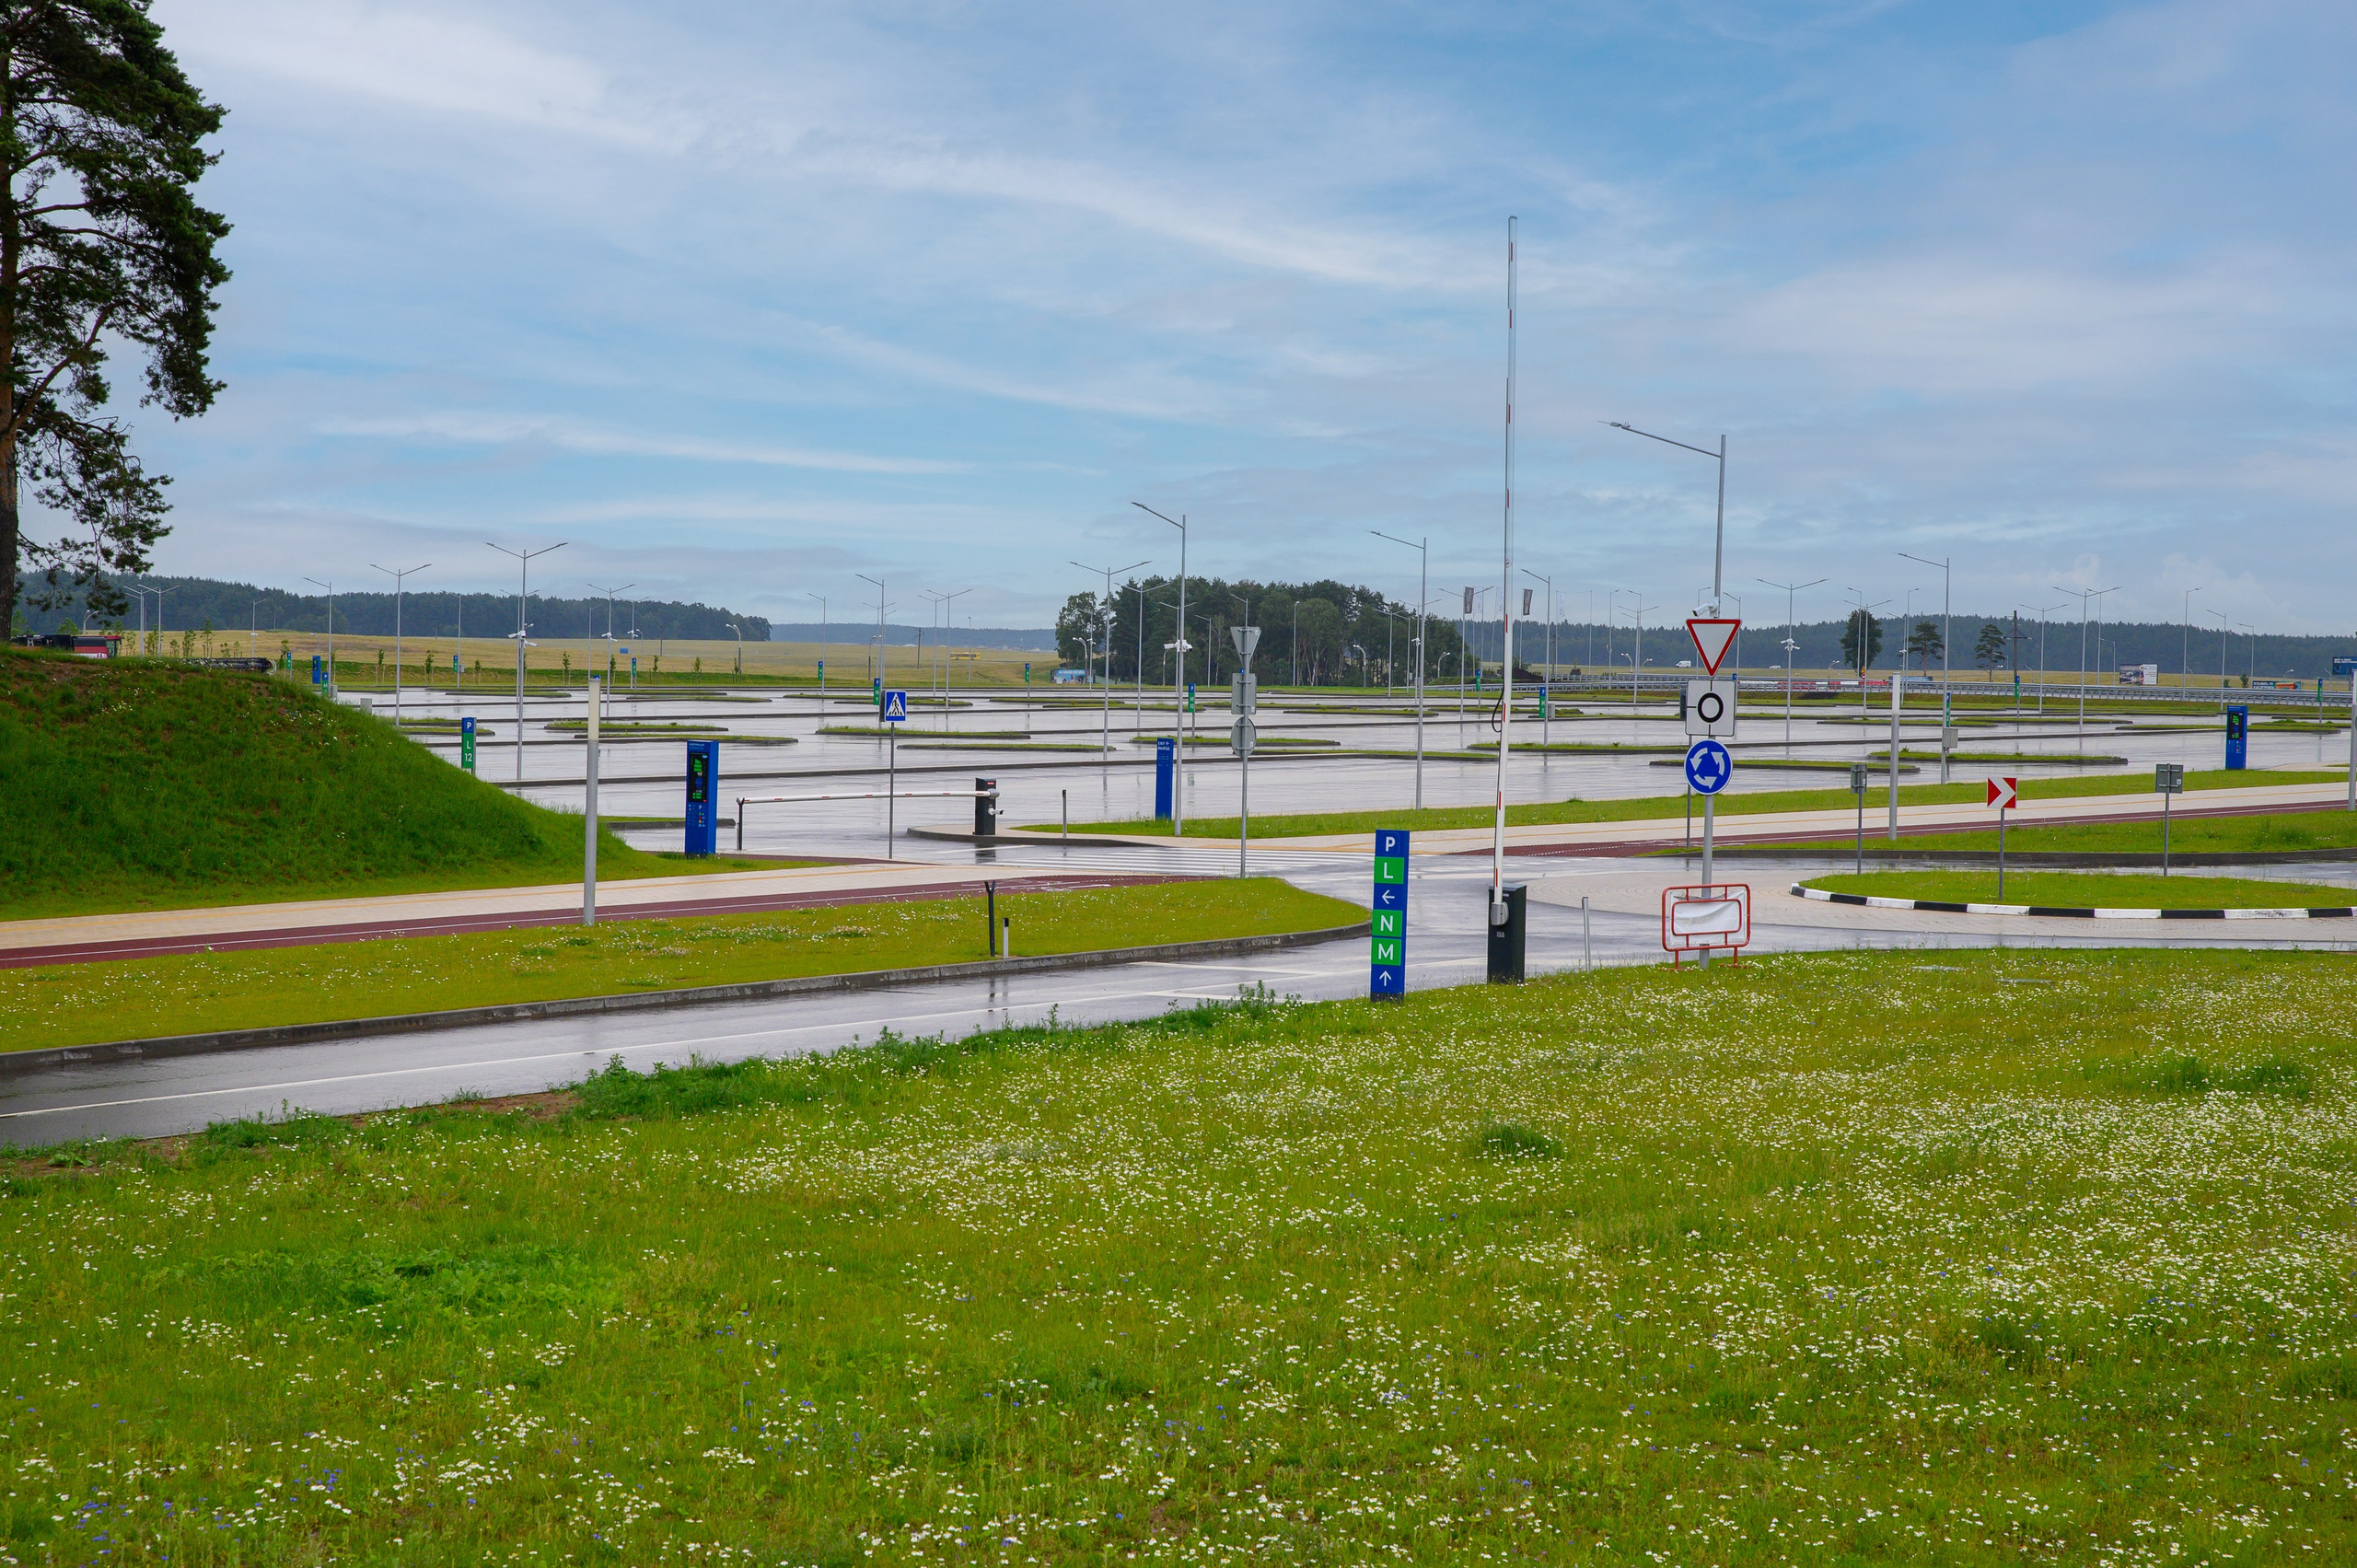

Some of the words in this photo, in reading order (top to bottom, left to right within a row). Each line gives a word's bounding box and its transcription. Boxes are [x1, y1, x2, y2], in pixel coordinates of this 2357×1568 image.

[466, 740, 471, 749] L
[464, 753, 472, 762] 12
[1385, 836, 1396, 852] P
[1383, 862, 1394, 879] L
[1380, 914, 1394, 933] N
[1377, 943, 1394, 960] M
